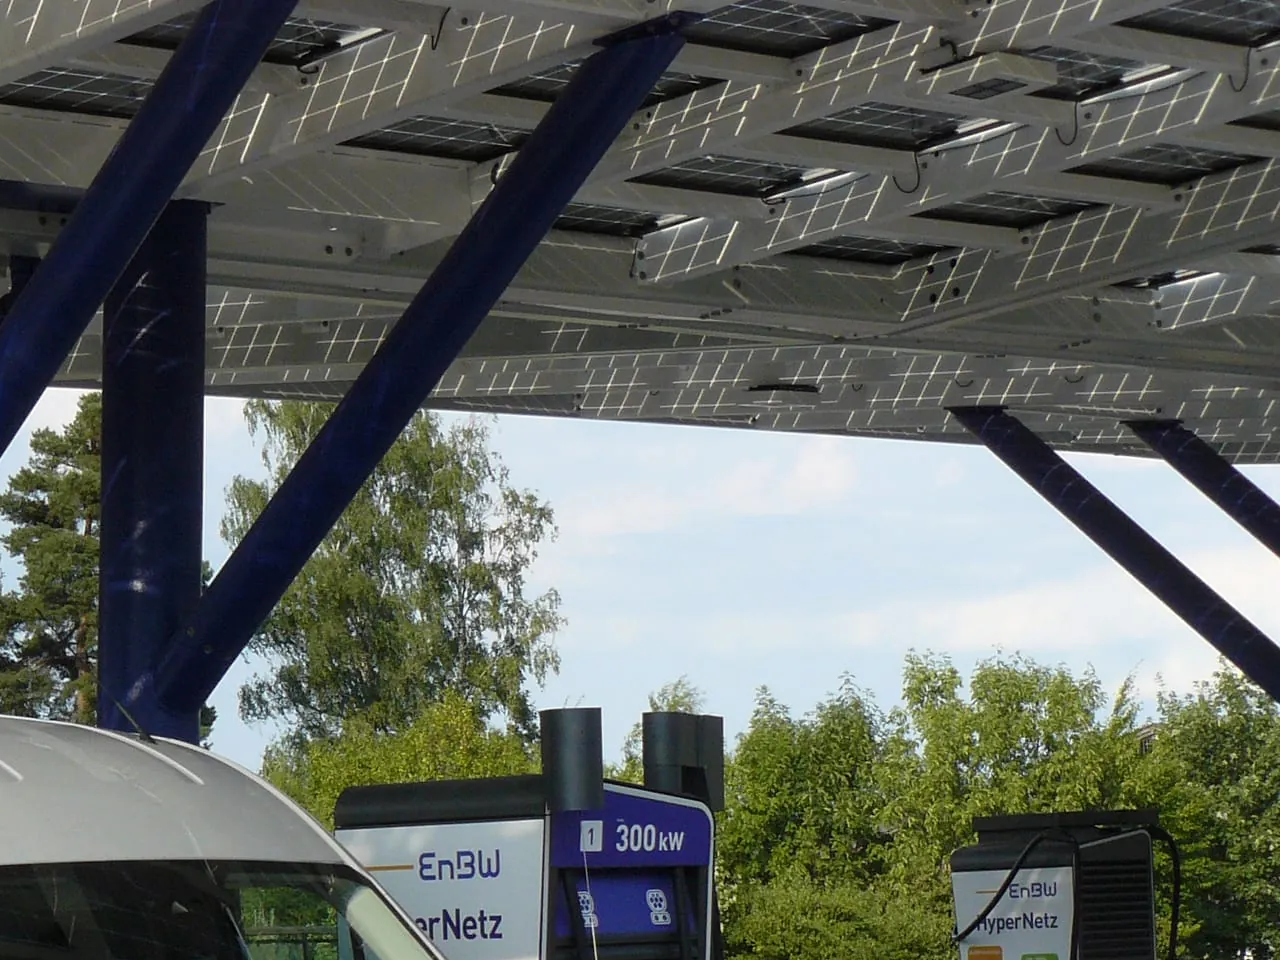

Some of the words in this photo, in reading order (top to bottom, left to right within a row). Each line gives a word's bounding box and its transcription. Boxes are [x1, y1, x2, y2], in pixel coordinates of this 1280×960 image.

[587, 827, 595, 846] 1
[616, 823, 656, 852] 300
[659, 831, 685, 852] kW
[418, 849, 501, 881] EnBW
[1008, 881, 1058, 899] EnBW
